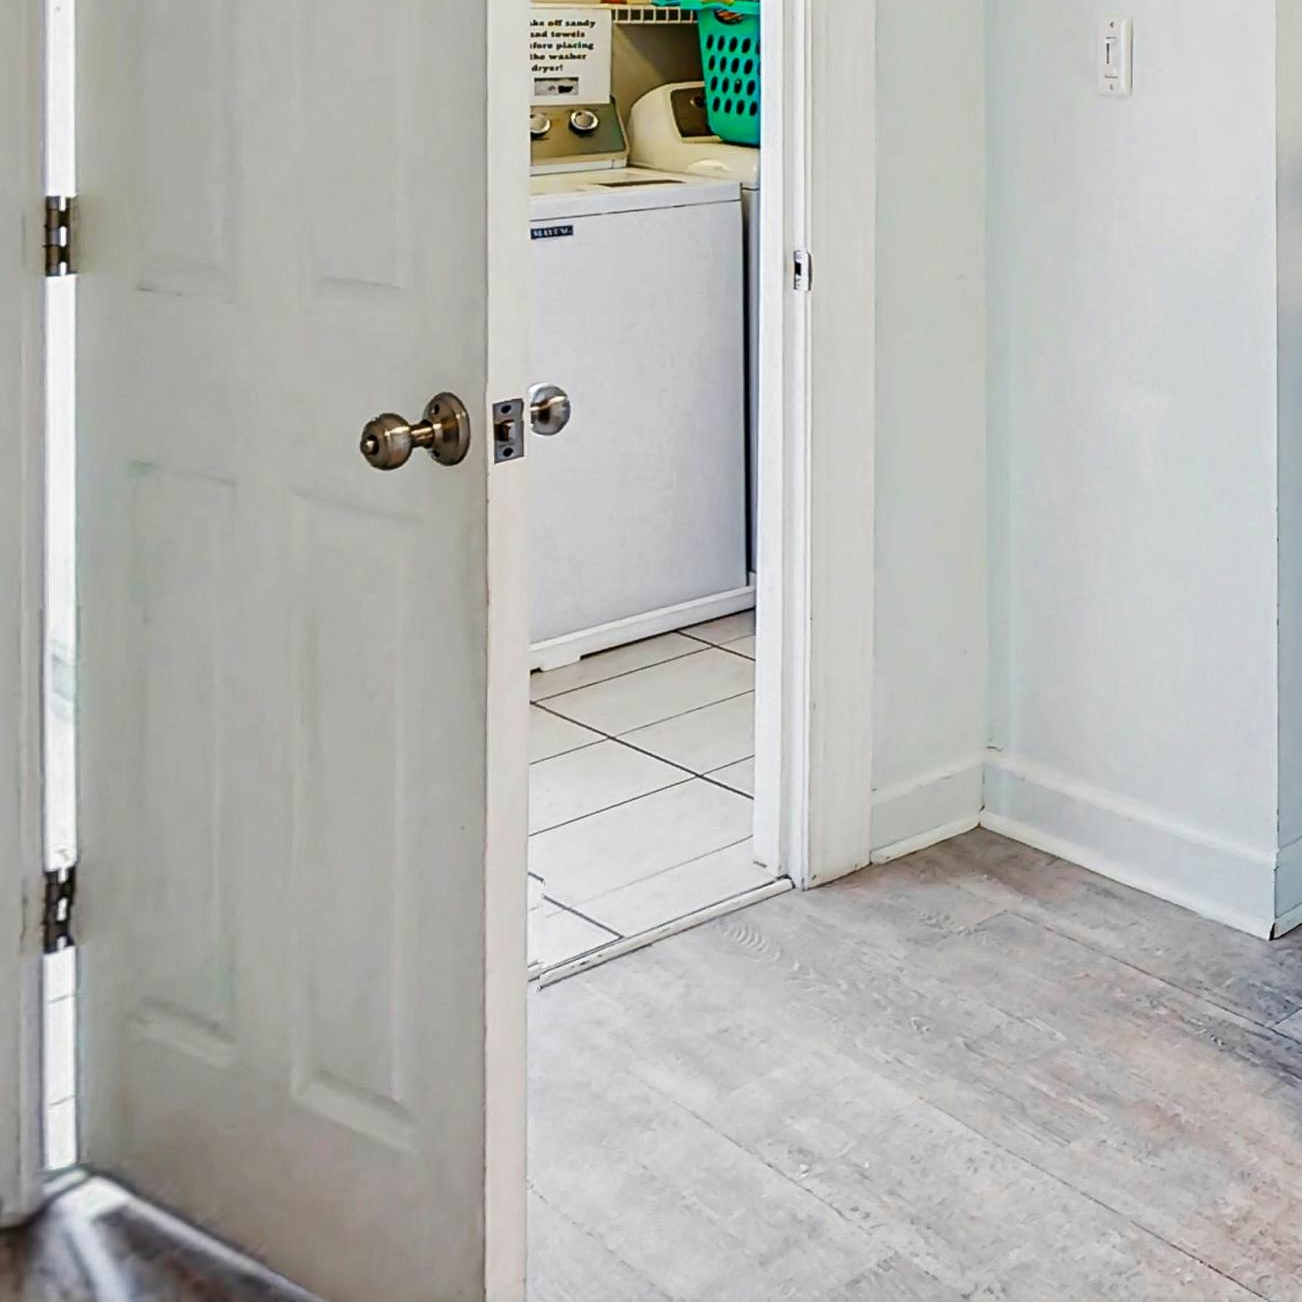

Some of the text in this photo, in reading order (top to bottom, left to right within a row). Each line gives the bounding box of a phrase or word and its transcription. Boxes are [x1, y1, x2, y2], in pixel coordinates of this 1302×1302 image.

[566, 20, 596, 28] sandy
[556, 42, 594, 50] placing
[532, 65, 563, 73] dryer!
